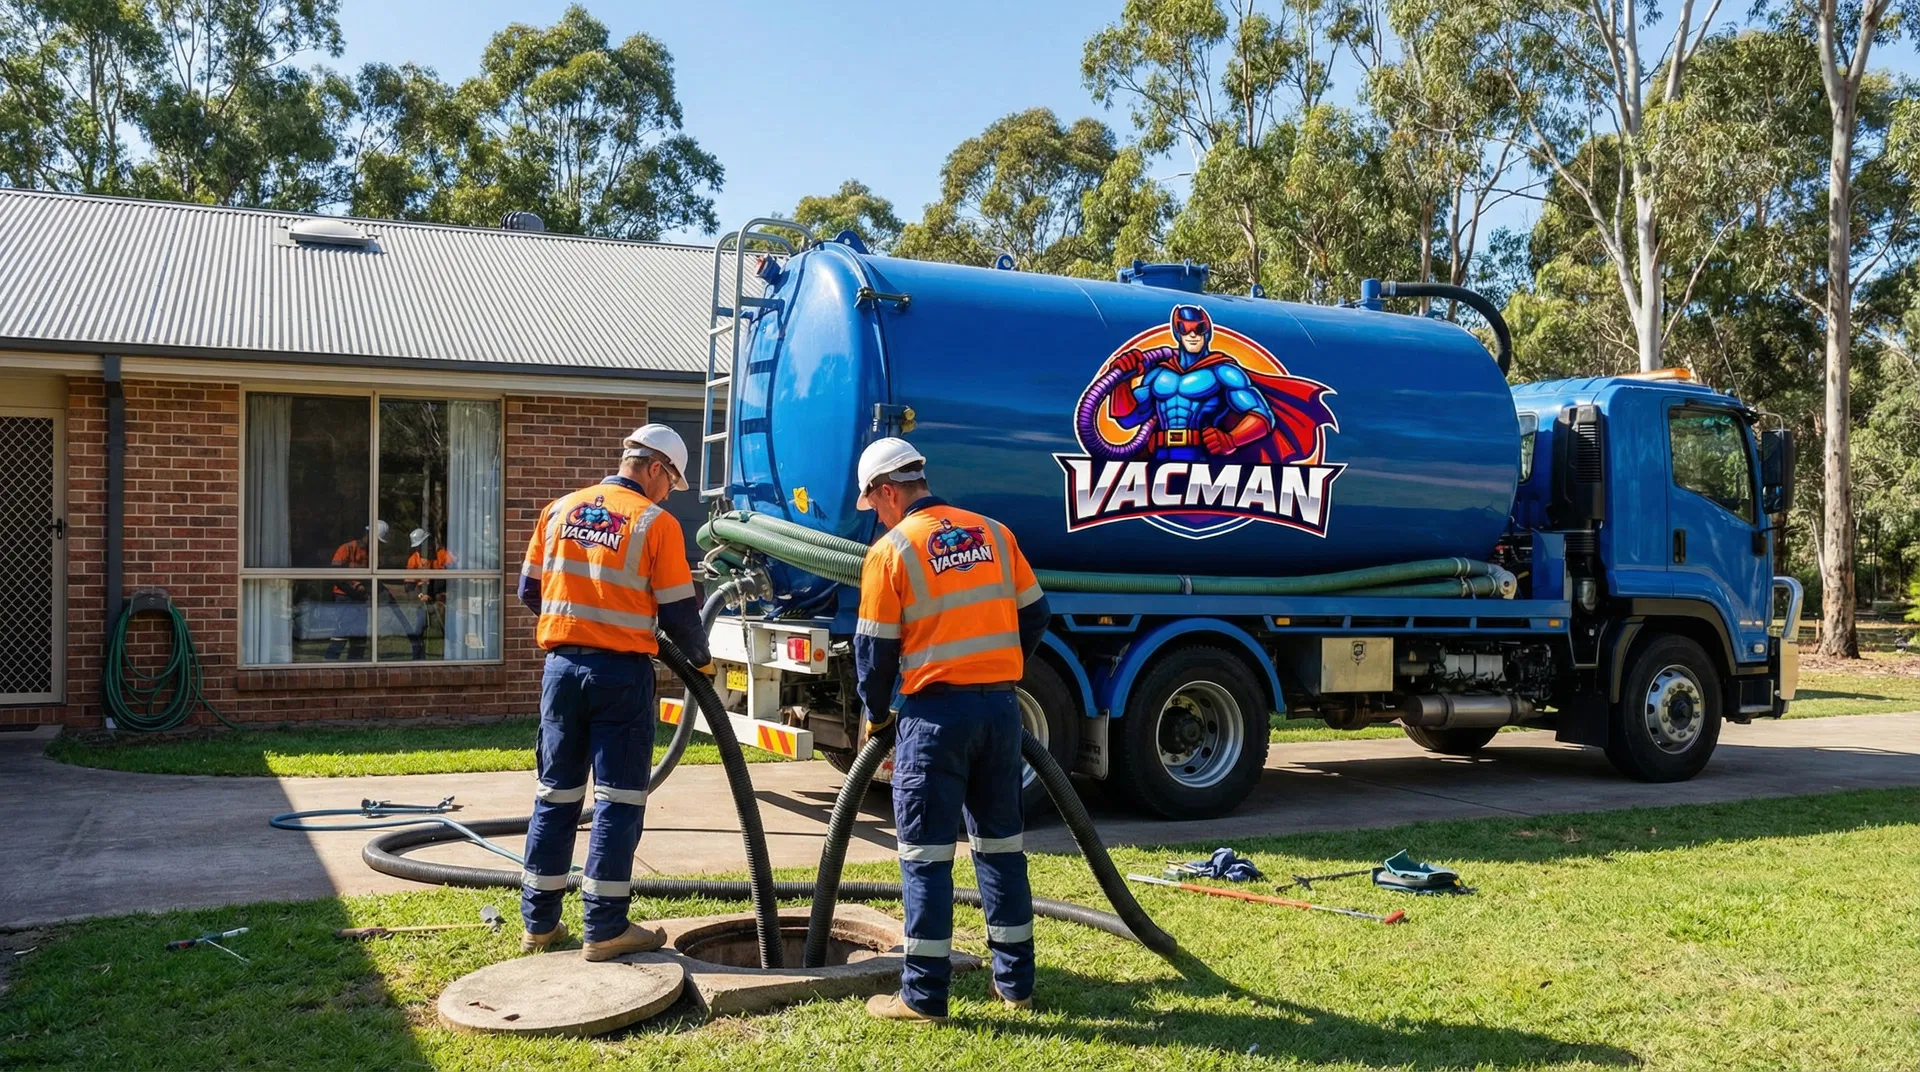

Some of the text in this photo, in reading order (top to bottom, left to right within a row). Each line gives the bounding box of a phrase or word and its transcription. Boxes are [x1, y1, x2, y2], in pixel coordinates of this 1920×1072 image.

[1065, 460, 1335, 526] VACMAN
[561, 524, 622, 550] VACMAN
[931, 545, 993, 574] VACMAN
